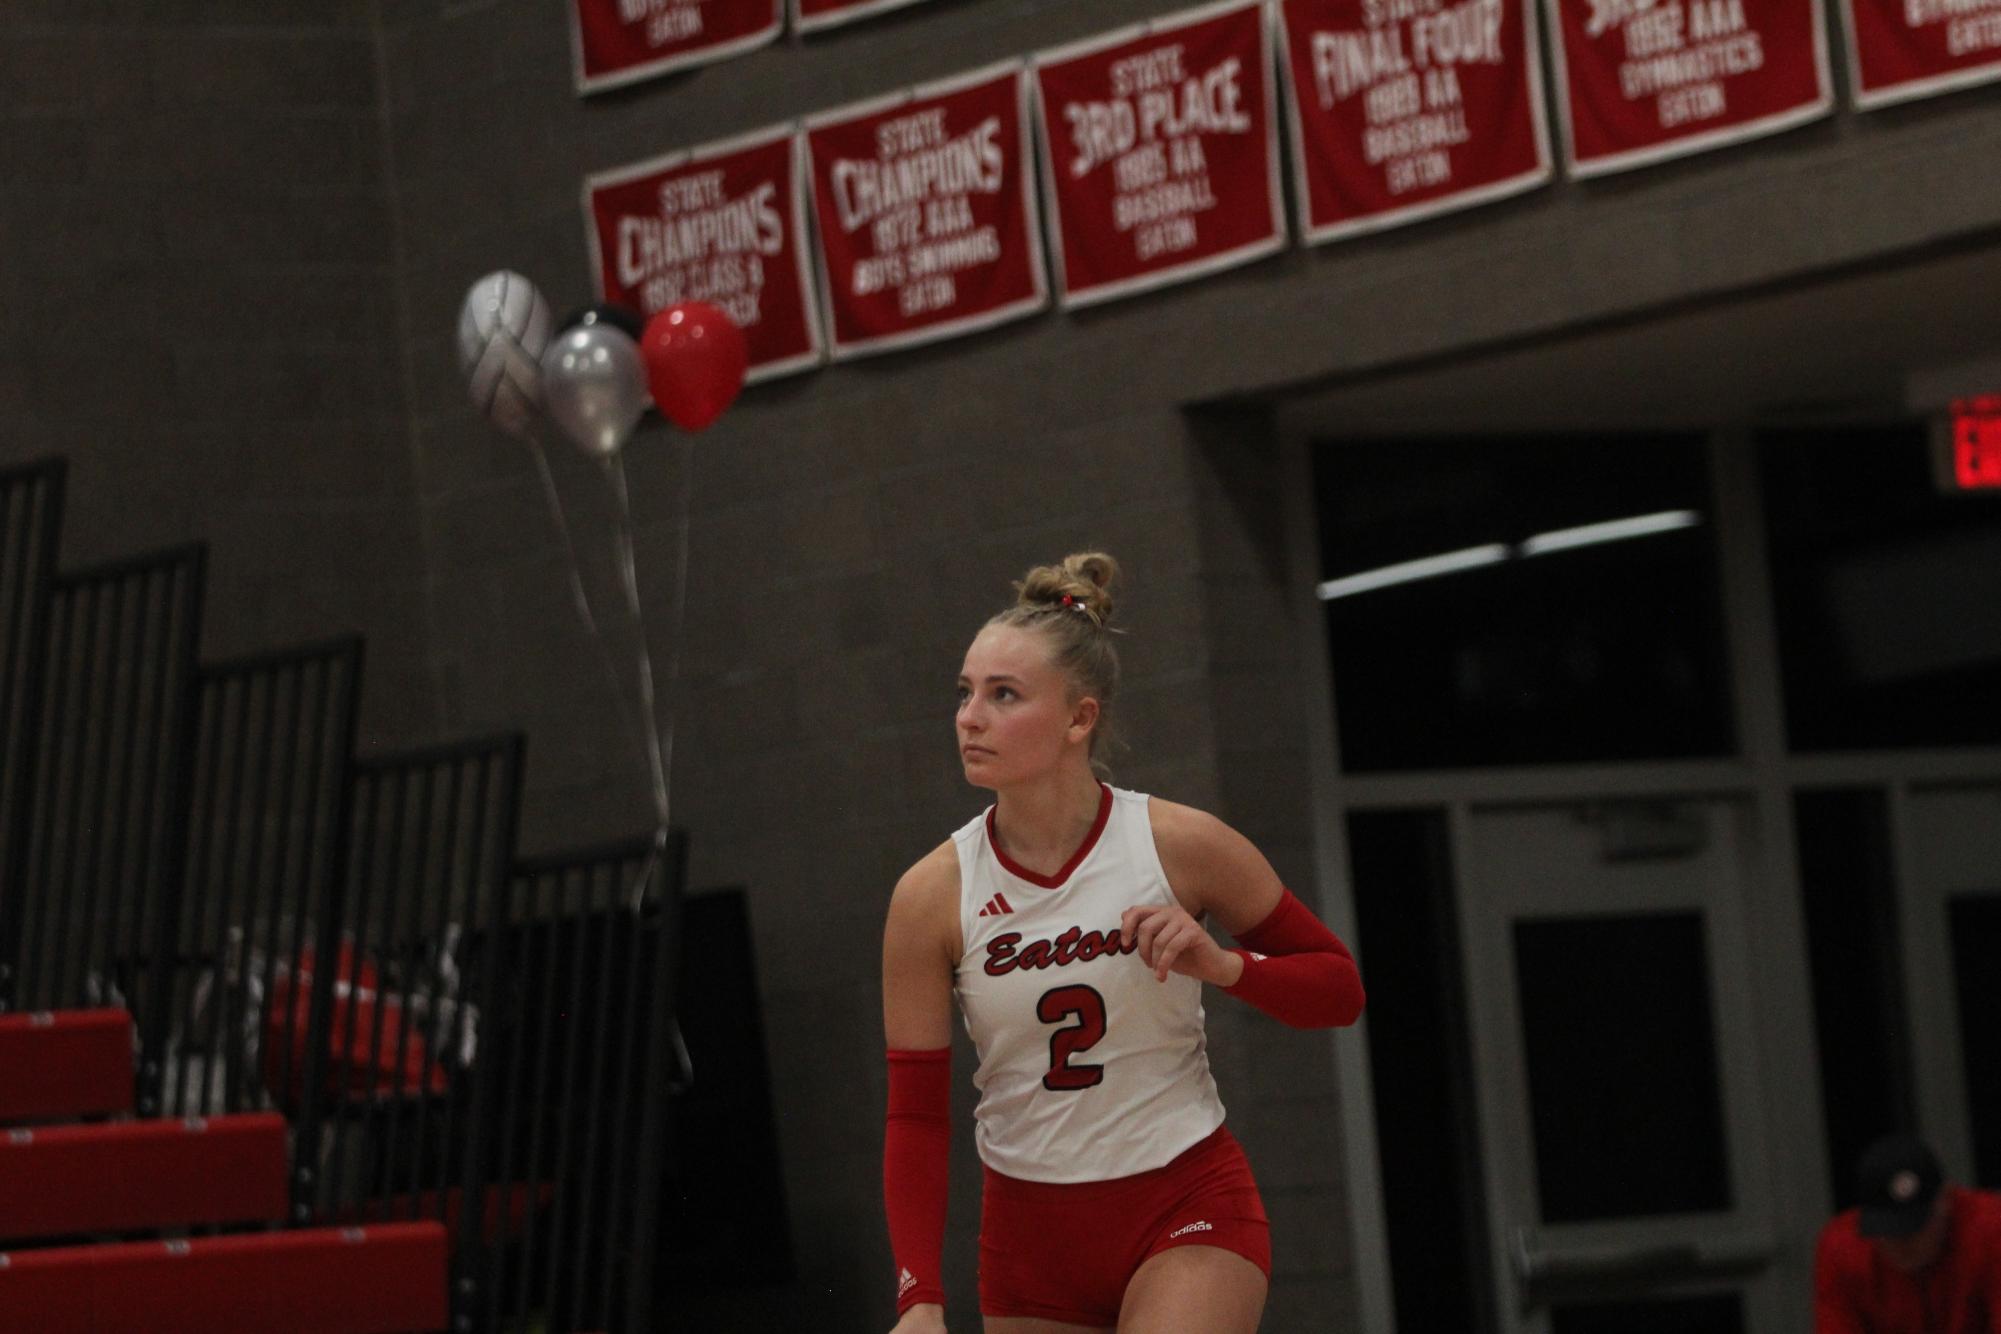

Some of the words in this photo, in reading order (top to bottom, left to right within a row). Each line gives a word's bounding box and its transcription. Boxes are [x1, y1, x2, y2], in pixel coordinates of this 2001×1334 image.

[1687, 0, 1746, 42] AAA
[1109, 43, 1184, 99] STATE
[1311, 22, 1413, 111] FINAL
[1411, 0, 1503, 71] FOUR
[1618, 30, 1764, 100] GYMNASTICS
[1423, 64, 1463, 110] AA
[1657, 81, 1727, 128] EATON
[875, 107, 948, 158] STATE
[1063, 98, 1137, 180] 3RD
[1137, 55, 1251, 142] PLACE
[1361, 108, 1472, 167] BASEBALL
[830, 115, 1004, 234] CHAMPIONS
[1168, 131, 1208, 177] AA
[1384, 147, 1452, 196] EATON
[659, 168, 728, 216] STATE
[924, 193, 975, 238] AAA
[1111, 174, 1218, 233] BASEBALL
[616, 179, 784, 289] CHAMPIONS
[1133, 212, 1198, 262] EATON
[851, 253, 908, 296] BOYS
[907, 224, 1002, 278] SWIMMING
[899, 272, 957, 318] EATON
[1036, 983, 1107, 1091] 2
[1170, 1220, 1212, 1238] adidas
